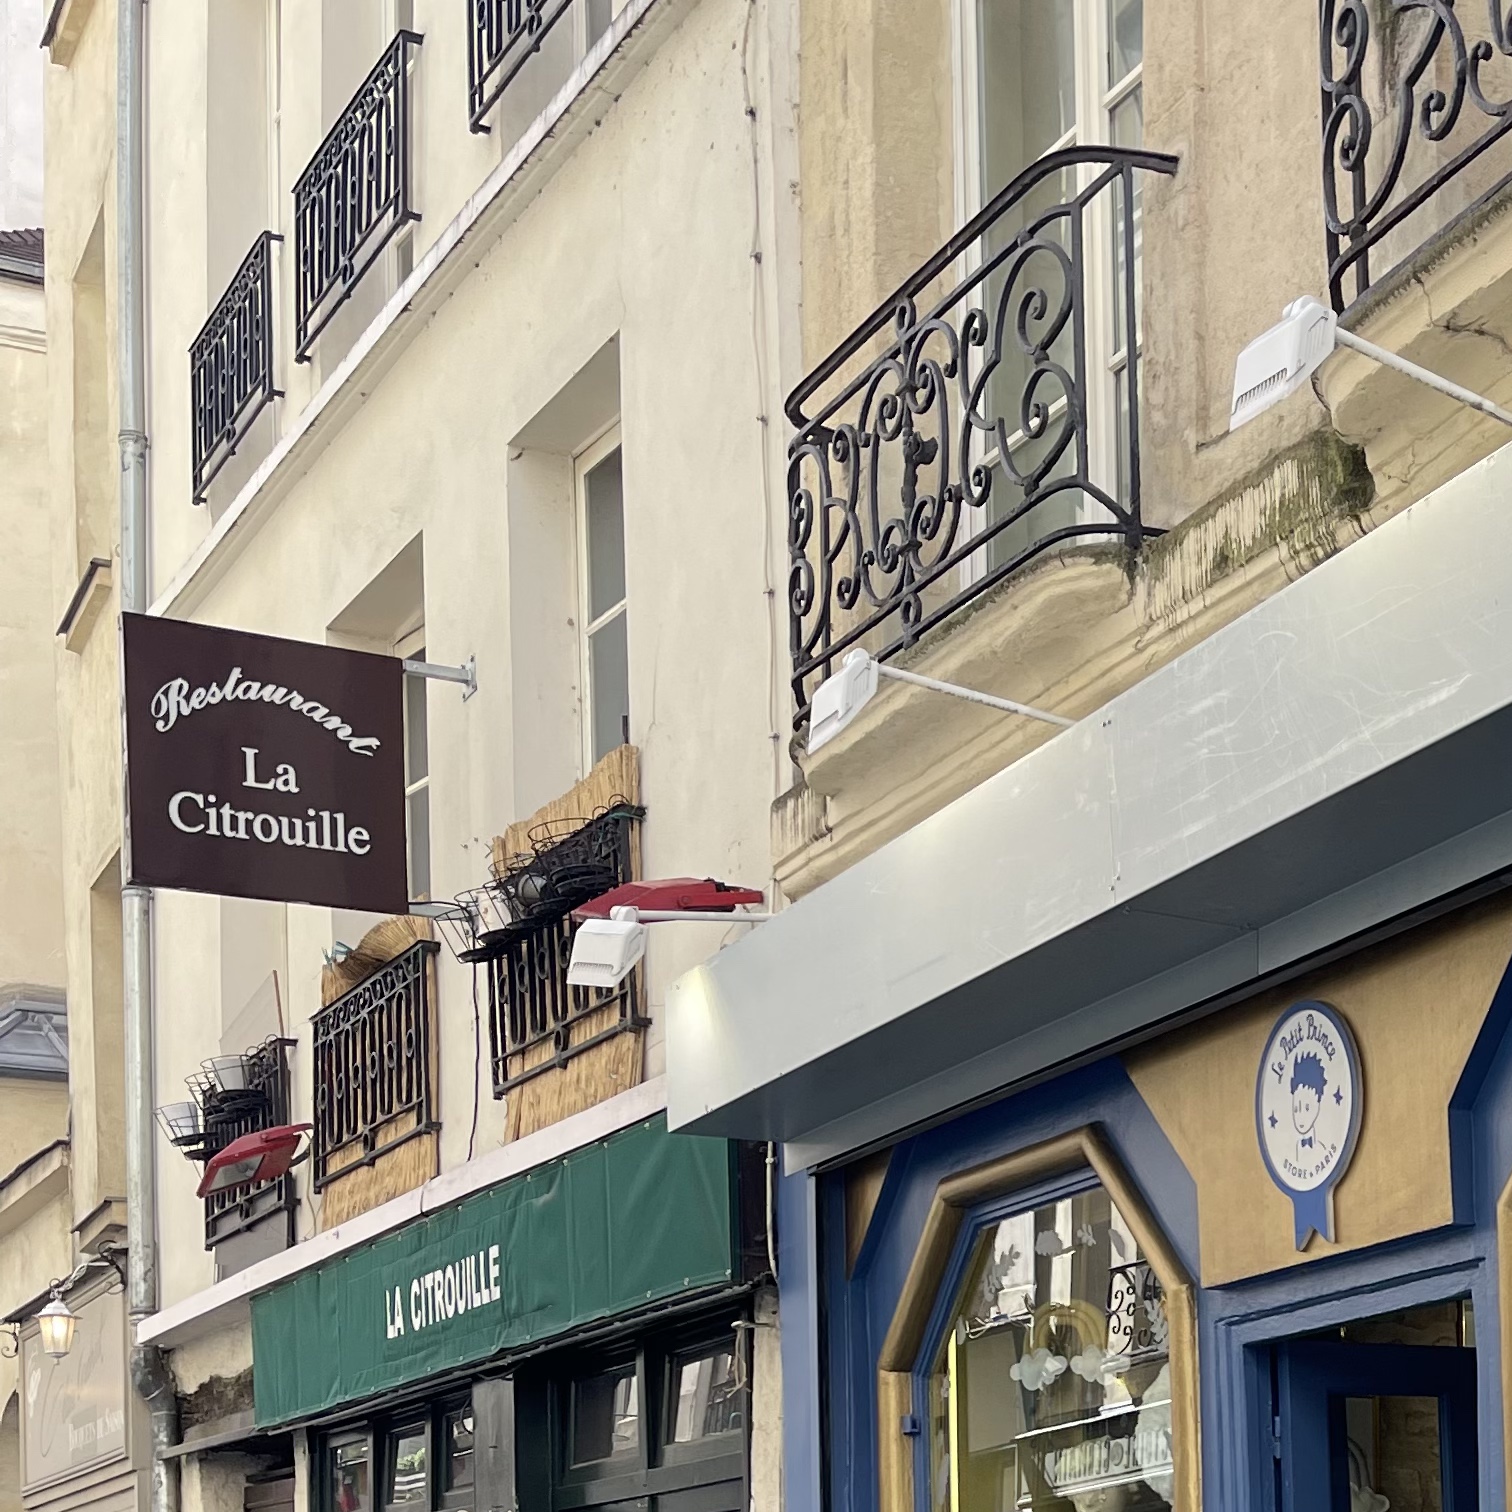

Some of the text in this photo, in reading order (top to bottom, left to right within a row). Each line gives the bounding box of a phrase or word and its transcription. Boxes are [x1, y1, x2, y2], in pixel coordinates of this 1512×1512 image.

[150, 666, 381, 757] Restaurant
[240, 746, 300, 794] La
[168, 790, 371, 855] Citrouille
[1271, 1013, 1336, 1084] Le Petit Prince
[1283, 1143, 1337, 1179] STORE PARIS
[385, 1244, 501, 1339] LA CITROUILLE
